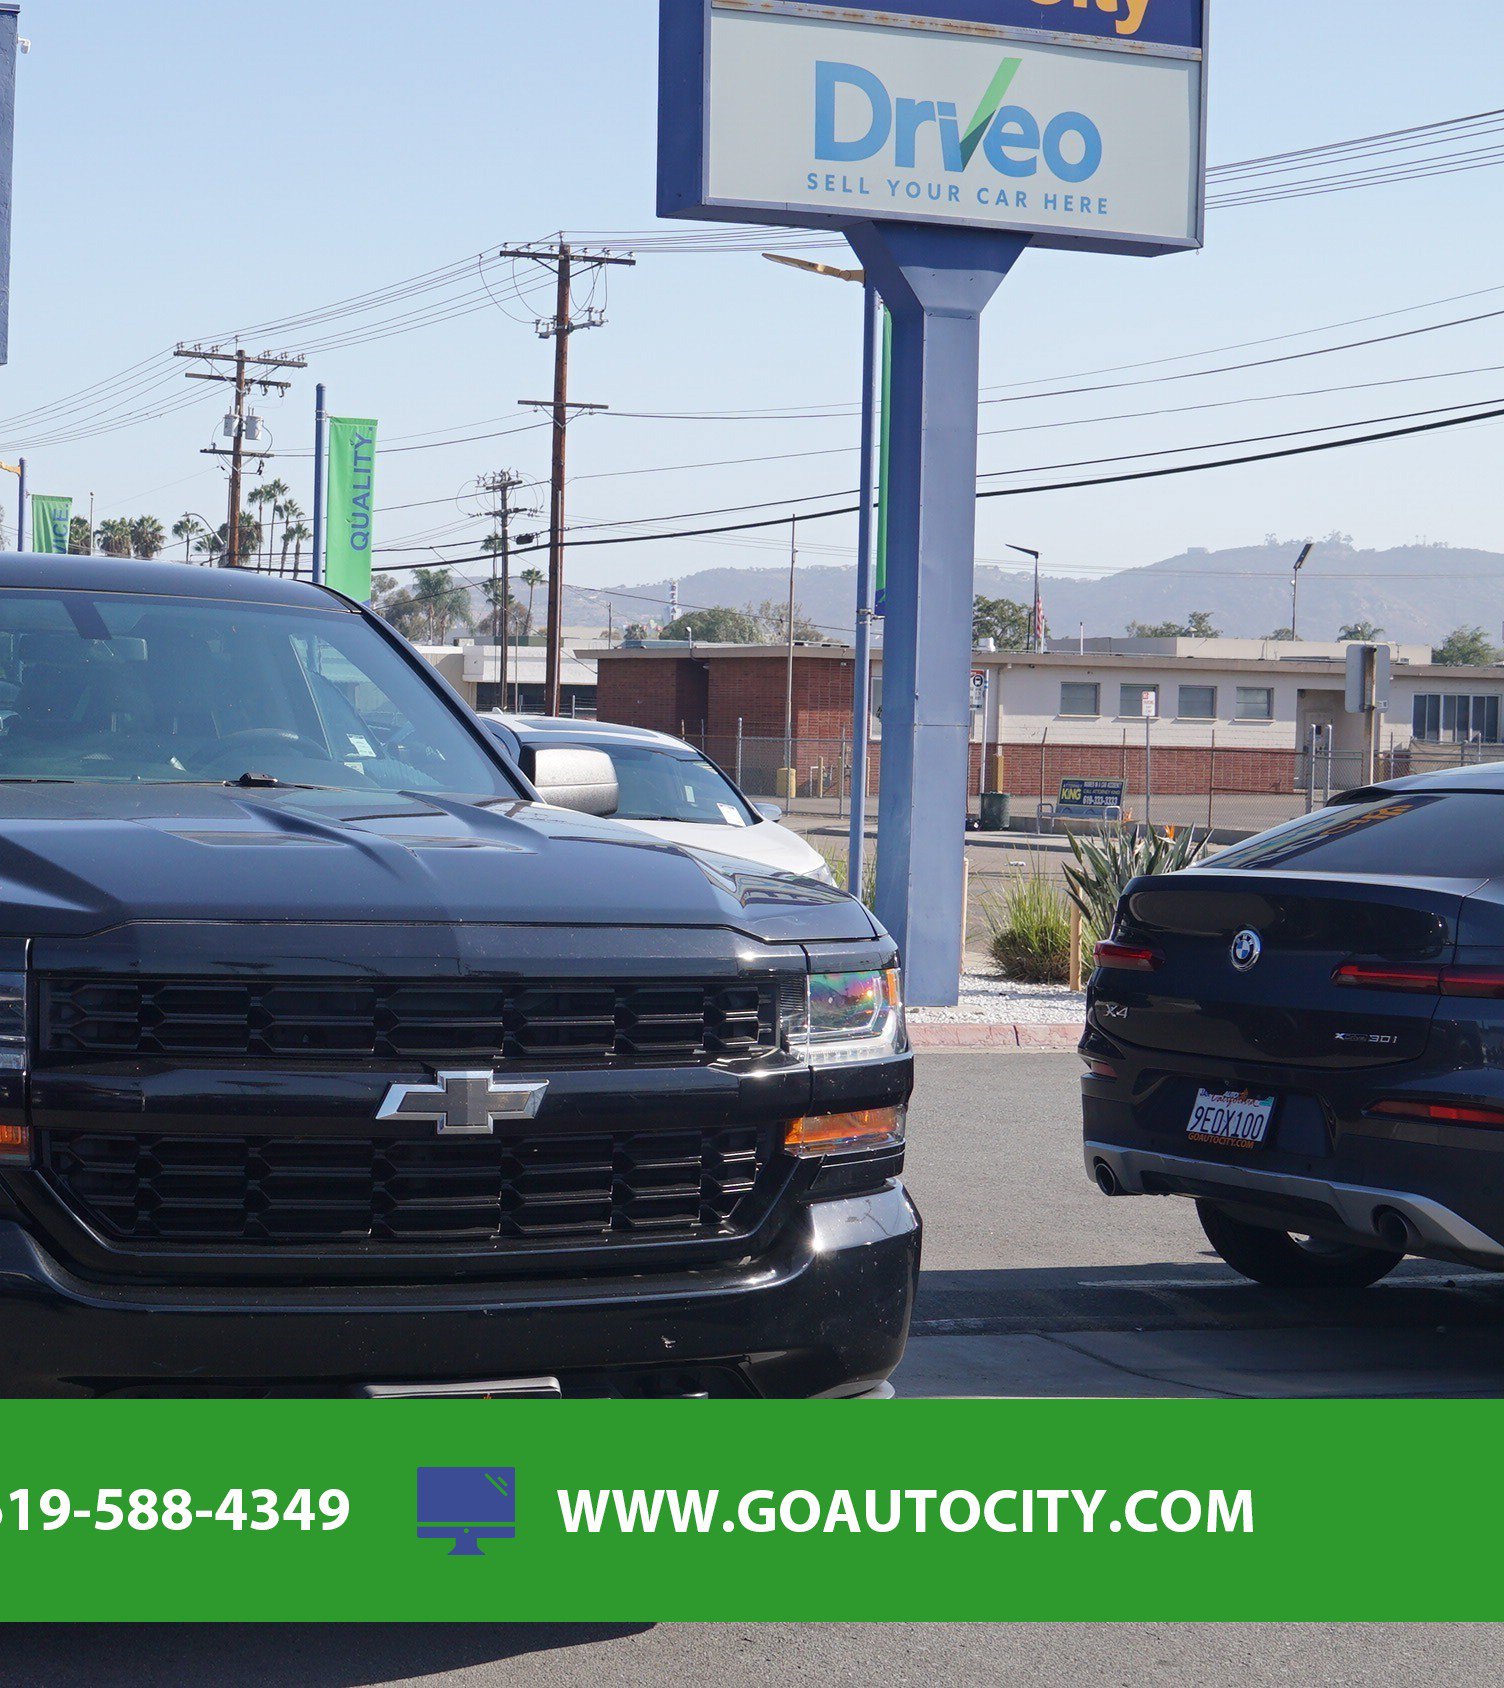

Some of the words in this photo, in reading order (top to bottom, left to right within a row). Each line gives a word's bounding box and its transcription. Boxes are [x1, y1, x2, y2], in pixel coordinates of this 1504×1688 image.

[814, 57, 1102, 183] Driveo
[807, 172, 870, 195] SELL
[887, 179, 960, 202] YOUR
[976, 187, 1027, 208] CAR
[1044, 193, 1108, 215] HERE
[1061, 788, 1082, 800] KING
[1103, 1004, 1128, 1019] X4
[1188, 1132, 1255, 1149] GOAUTOCITY.COM
